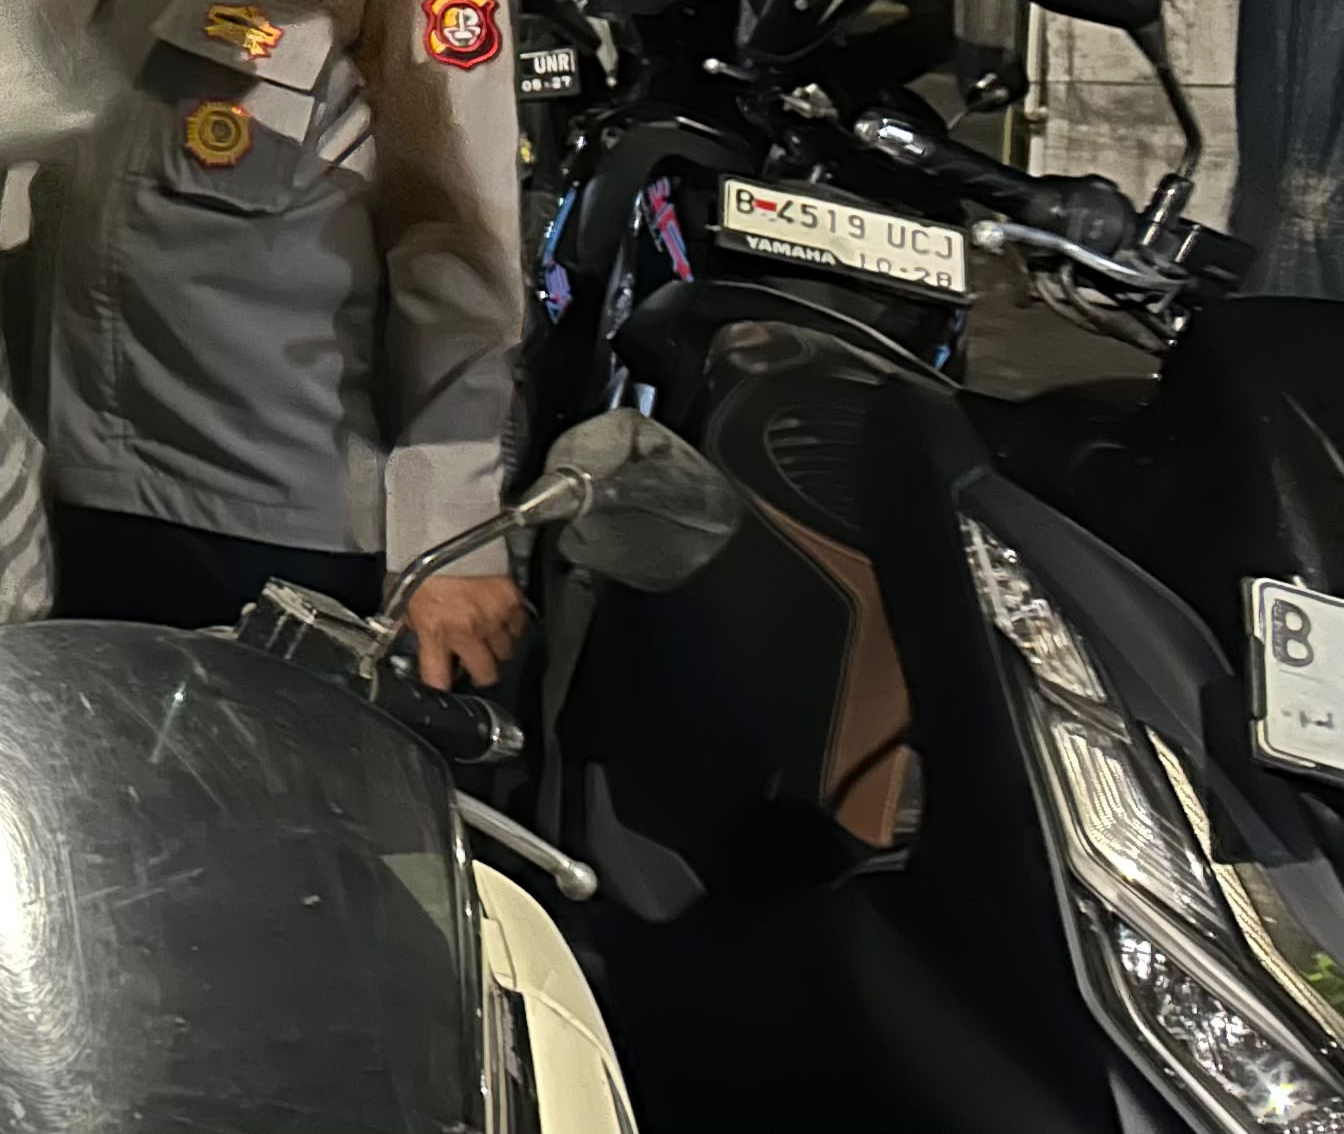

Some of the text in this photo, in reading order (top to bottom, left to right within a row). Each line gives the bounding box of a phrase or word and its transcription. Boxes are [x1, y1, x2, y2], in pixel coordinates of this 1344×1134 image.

[534, 53, 570, 74] UNR
[746, 234, 837, 267] YAMAHA
[776, 200, 866, 240] 4519
[887, 222, 954, 260] UCJ
[1271, 599, 1314, 668] B
